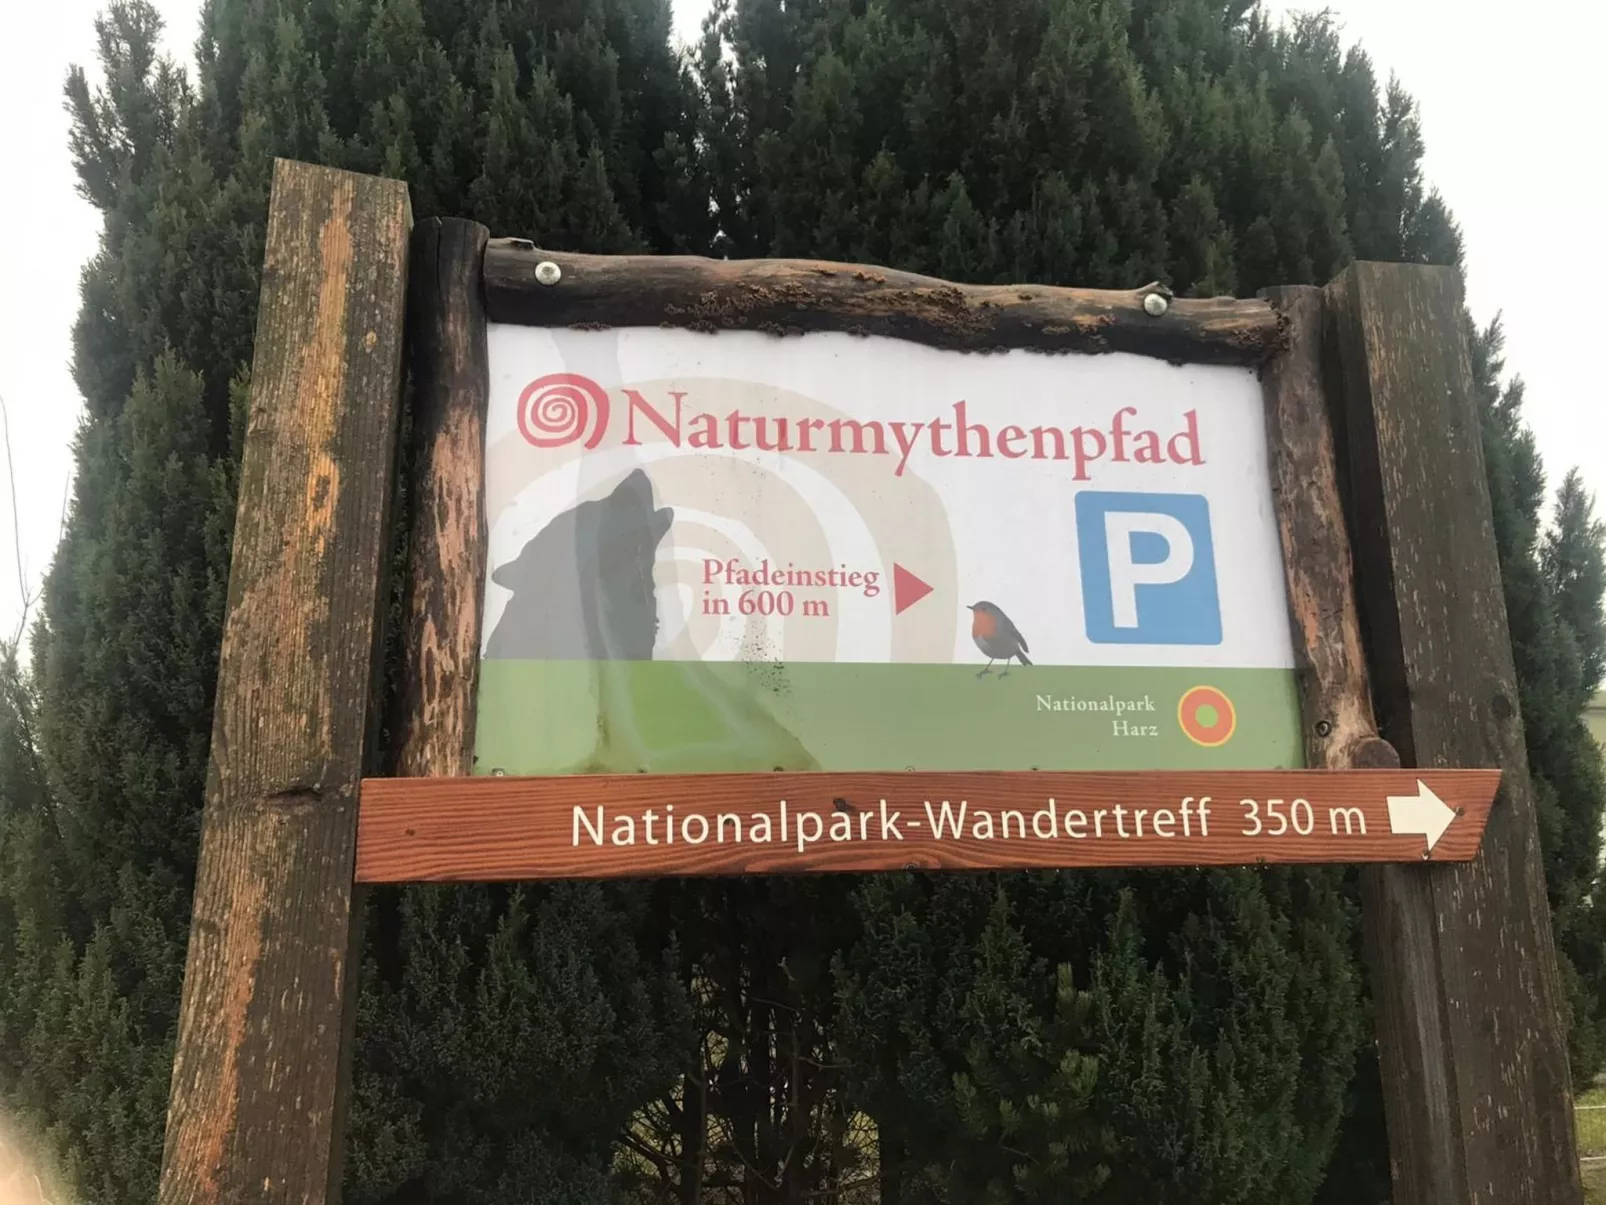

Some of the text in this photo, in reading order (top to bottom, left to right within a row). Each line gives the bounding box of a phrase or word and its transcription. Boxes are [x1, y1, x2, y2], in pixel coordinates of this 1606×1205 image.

[621, 389, 1206, 480] Naturmythenpfad
[702, 559, 880, 597] Pfadeinstieg
[1104, 511, 1195, 628] P
[702, 589, 830, 617] in 600 m
[1036, 694, 1155, 717] Nationalpark
[1112, 720, 1159, 737] Harz
[572, 796, 1367, 852] Nationalpark-Wandertreff 350 m
